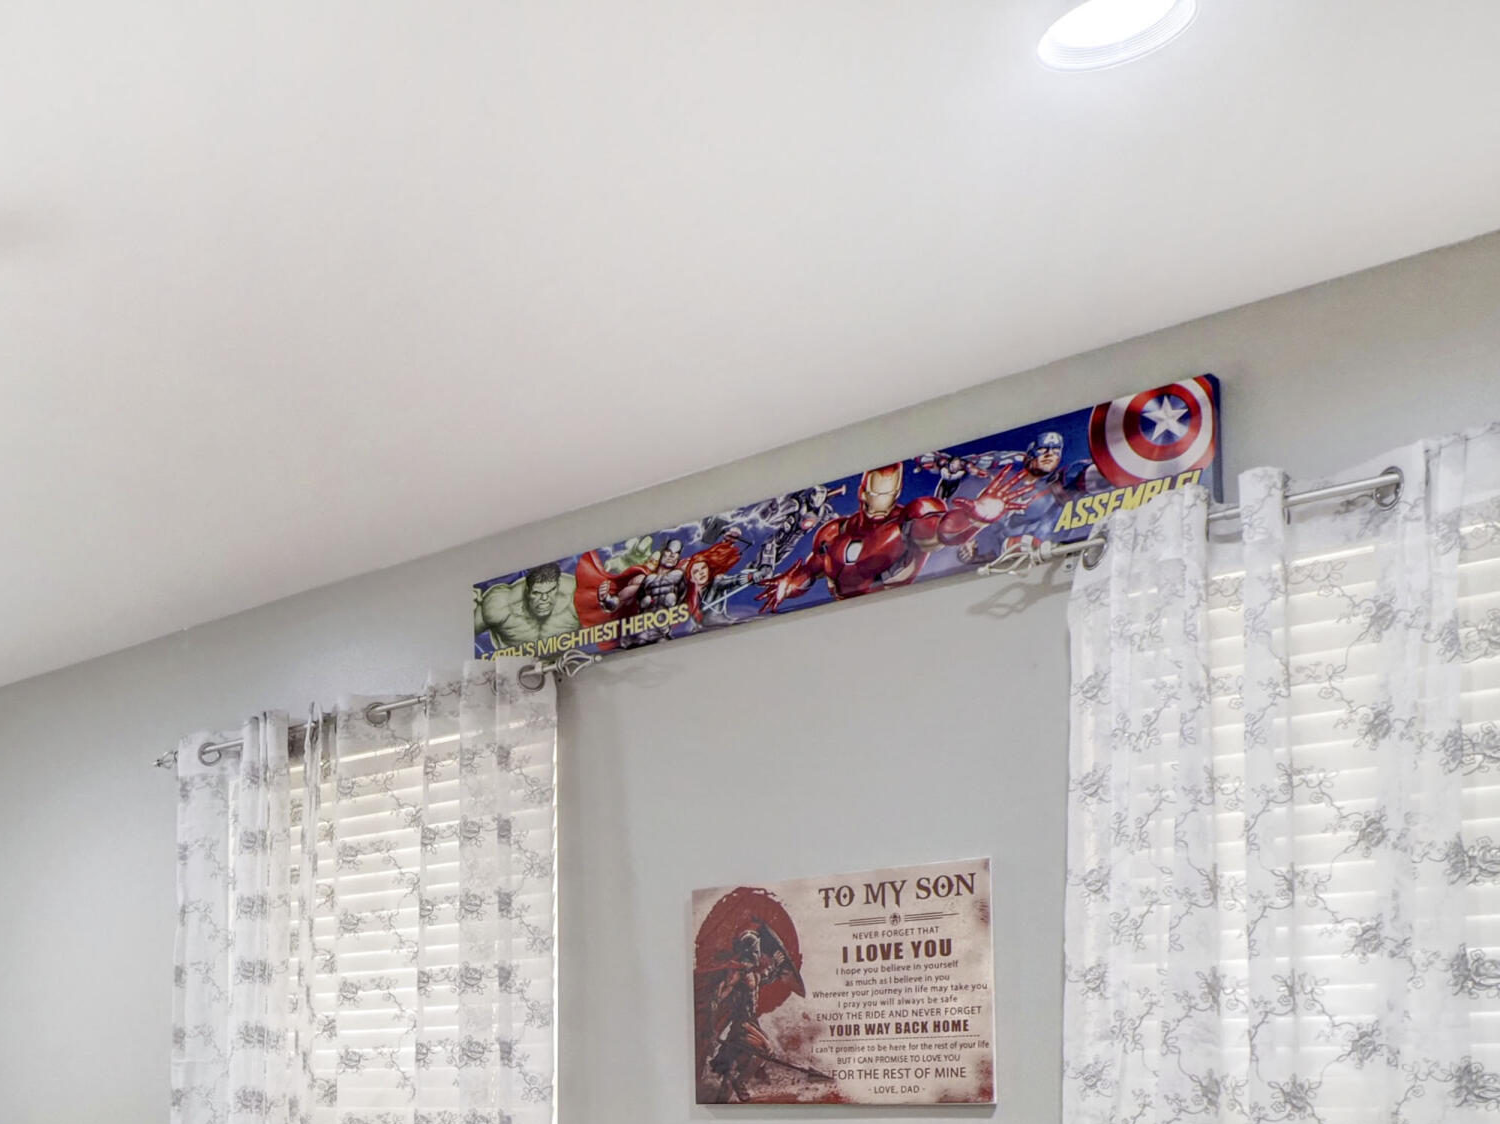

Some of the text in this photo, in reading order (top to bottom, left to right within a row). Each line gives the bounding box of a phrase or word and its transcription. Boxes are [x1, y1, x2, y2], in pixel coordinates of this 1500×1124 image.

[537, 620, 620, 657] MIGHTIEST
[621, 603, 690, 636] HEROES
[818, 872, 976, 909] TO MY SON
[852, 926, 940, 940] NEVER FORGET THAT
[842, 938, 952, 963] I LOVE YOU
[841, 967, 861, 976] hope
[863, 968, 878, 976] you
[881, 964, 911, 973] believe
[913, 963, 922, 971] in
[924, 960, 958, 972] yourself
[855, 977, 877, 986] much
[893, 975, 923, 984] believe
[934, 975, 950, 983] you
[812, 990, 849, 998] Wherever
[851, 990, 869, 998] your
[871, 988, 902, 998] journey
[914, 985, 929, 993] life
[930, 985, 949, 993] may
[950, 983, 970, 991] take
[970, 983, 988, 992] you
[843, 1000, 861, 1009] pray
[862, 1000, 878, 1009] you
[880, 998, 895, 1006] will
[897, 997, 925, 1007] always
[927, 996, 938, 1004] be
[940, 995, 958, 1004] safe
[816, 1005, 982, 1021] ENJOY THE RIDE AND NEVER FORGET
[829, 1019, 970, 1037] YOUR WAY BACK HOME
[815, 1045, 834, 1053] can't
[835, 1045, 865, 1054] promise
[877, 1043, 887, 1051] be
[889, 1043, 907, 1051] here
[908, 1042, 919, 1050] for
[920, 1042, 933, 1050] the
[949, 1041, 958, 1049] of
[959, 1041, 976, 1050] your
[977, 1040, 990, 1048] life
[837, 1056, 851, 1064] BUT
[858, 1055, 873, 1064] CAN
[875, 1055, 908, 1064] PROMISE
[910, 1054, 921, 1063] TO
[922, 1054, 942, 1062] LOVE
[943, 1054, 961, 1062] YOU
[831, 1067, 967, 1080] FOR THE REST OF MINE
[900, 1085, 920, 1094] DAD
